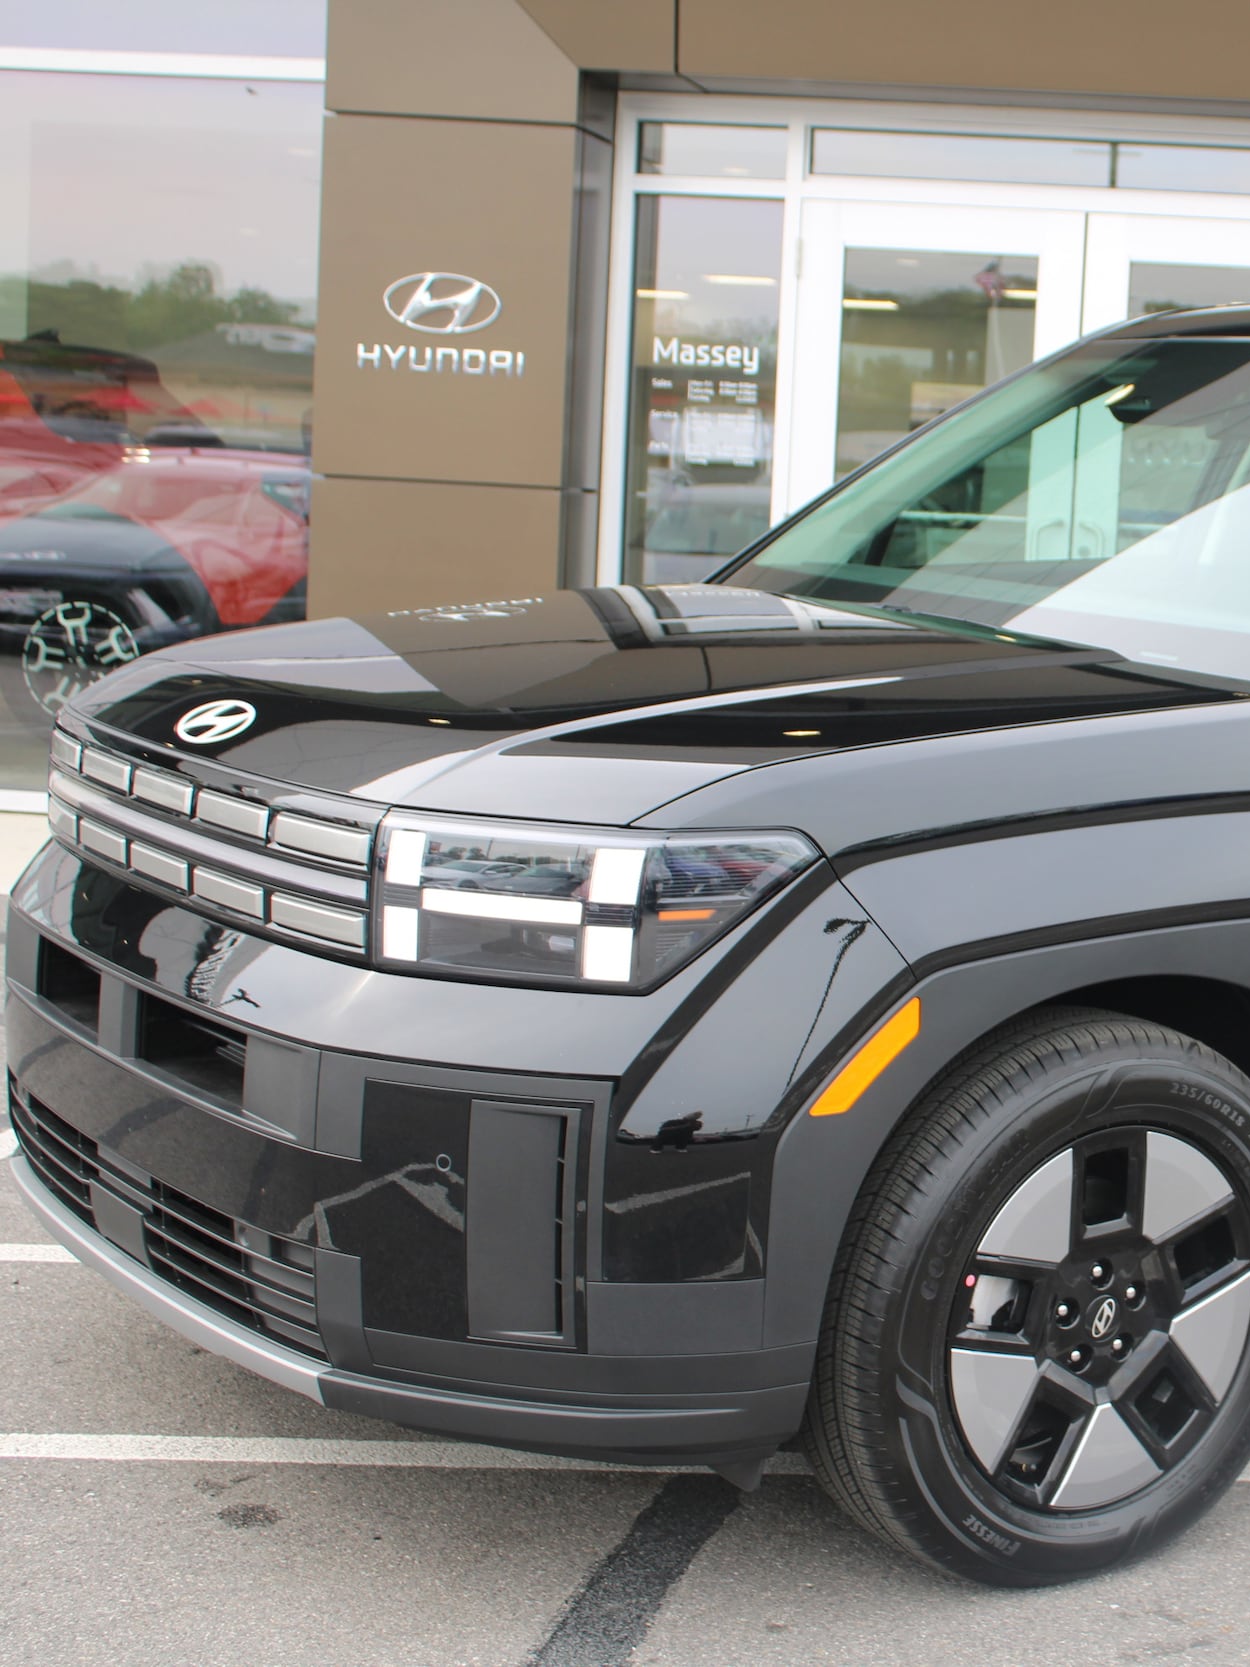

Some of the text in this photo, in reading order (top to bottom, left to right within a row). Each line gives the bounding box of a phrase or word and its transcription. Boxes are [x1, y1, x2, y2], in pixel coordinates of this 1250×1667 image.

[357, 343, 525, 378] HYUNDAI
[652, 336, 759, 375] Massey
[1170, 1081, 1246, 1127] 235/60R18
[962, 1513, 1022, 1557] FINESSE
